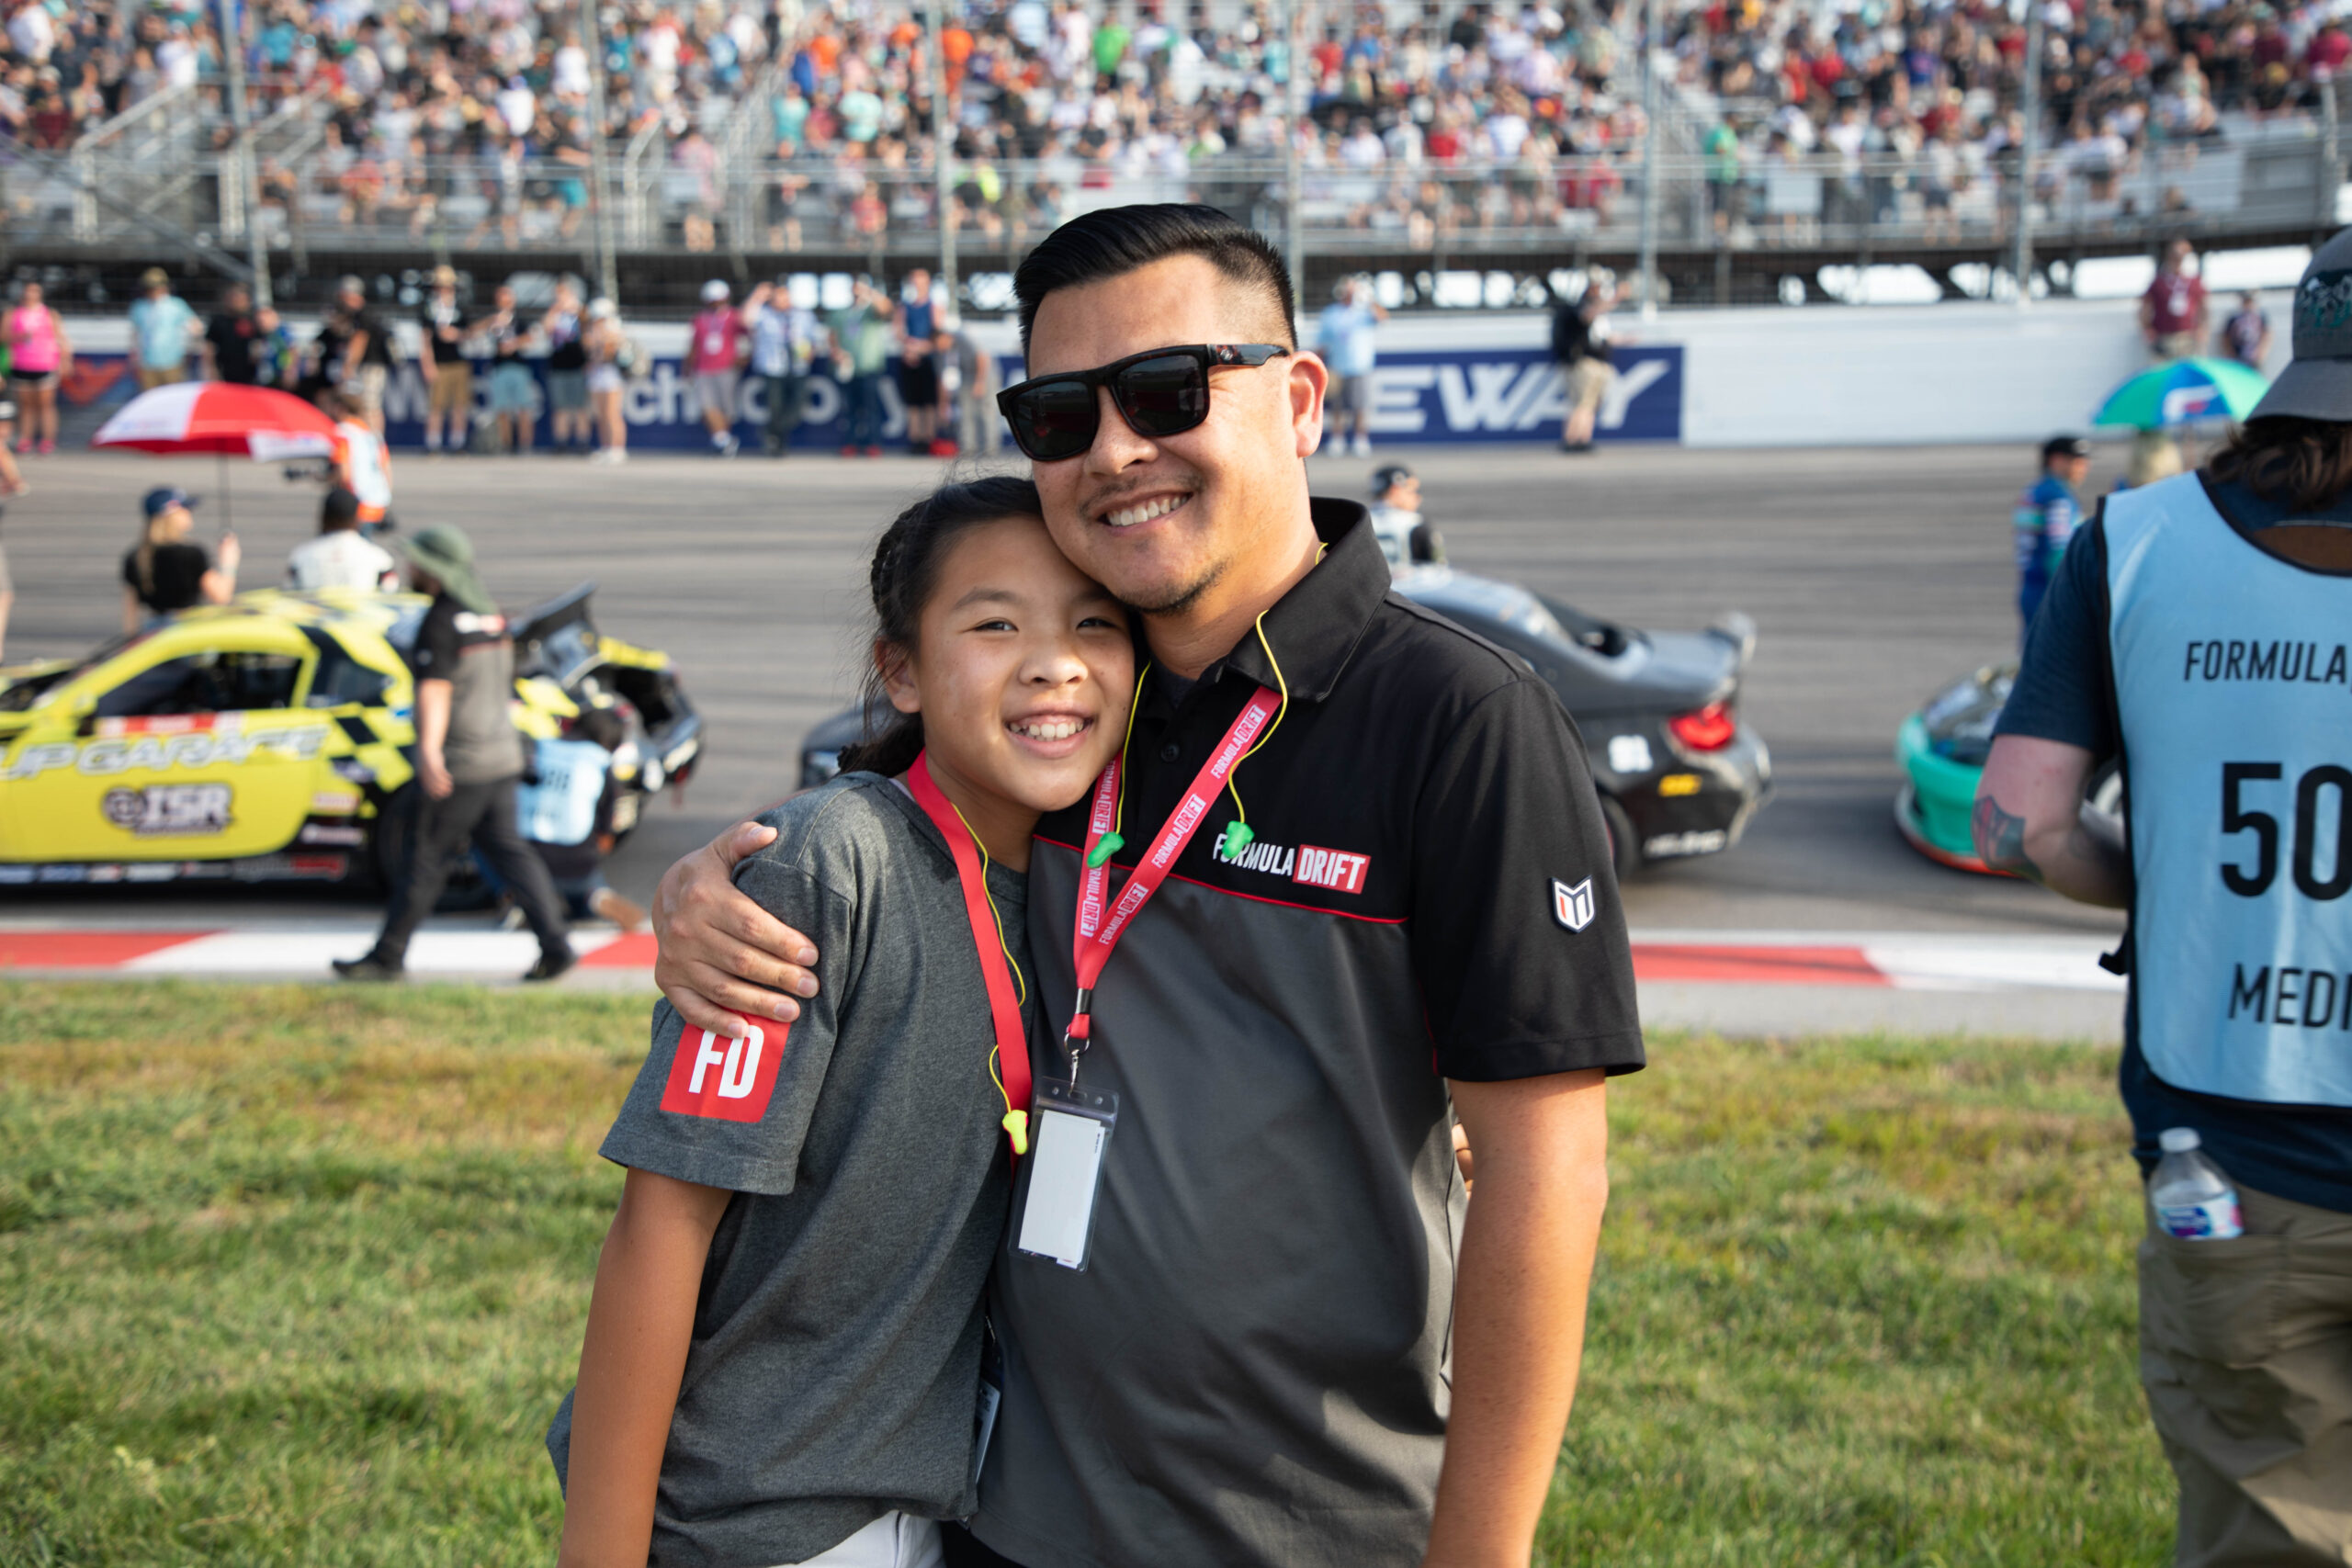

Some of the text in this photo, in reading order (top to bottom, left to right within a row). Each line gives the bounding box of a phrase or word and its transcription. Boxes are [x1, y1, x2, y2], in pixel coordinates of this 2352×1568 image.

[1325, 359, 1670, 432] EWAY
[2184, 639, 2346, 683] FORMULA
[1210, 704, 1267, 779] FORMULA DRIFT
[1092, 799, 1113, 834] DRIFT
[1151, 793, 1206, 869] FORMULA DRIFT
[2220, 761, 2352, 901] 50
[1213, 833, 1366, 890] FRMULA DRIFT
[1080, 899, 1101, 937] DRIFT
[1099, 882, 1148, 944] FORMULA DRIFT
[688, 1025, 764, 1099] FD
